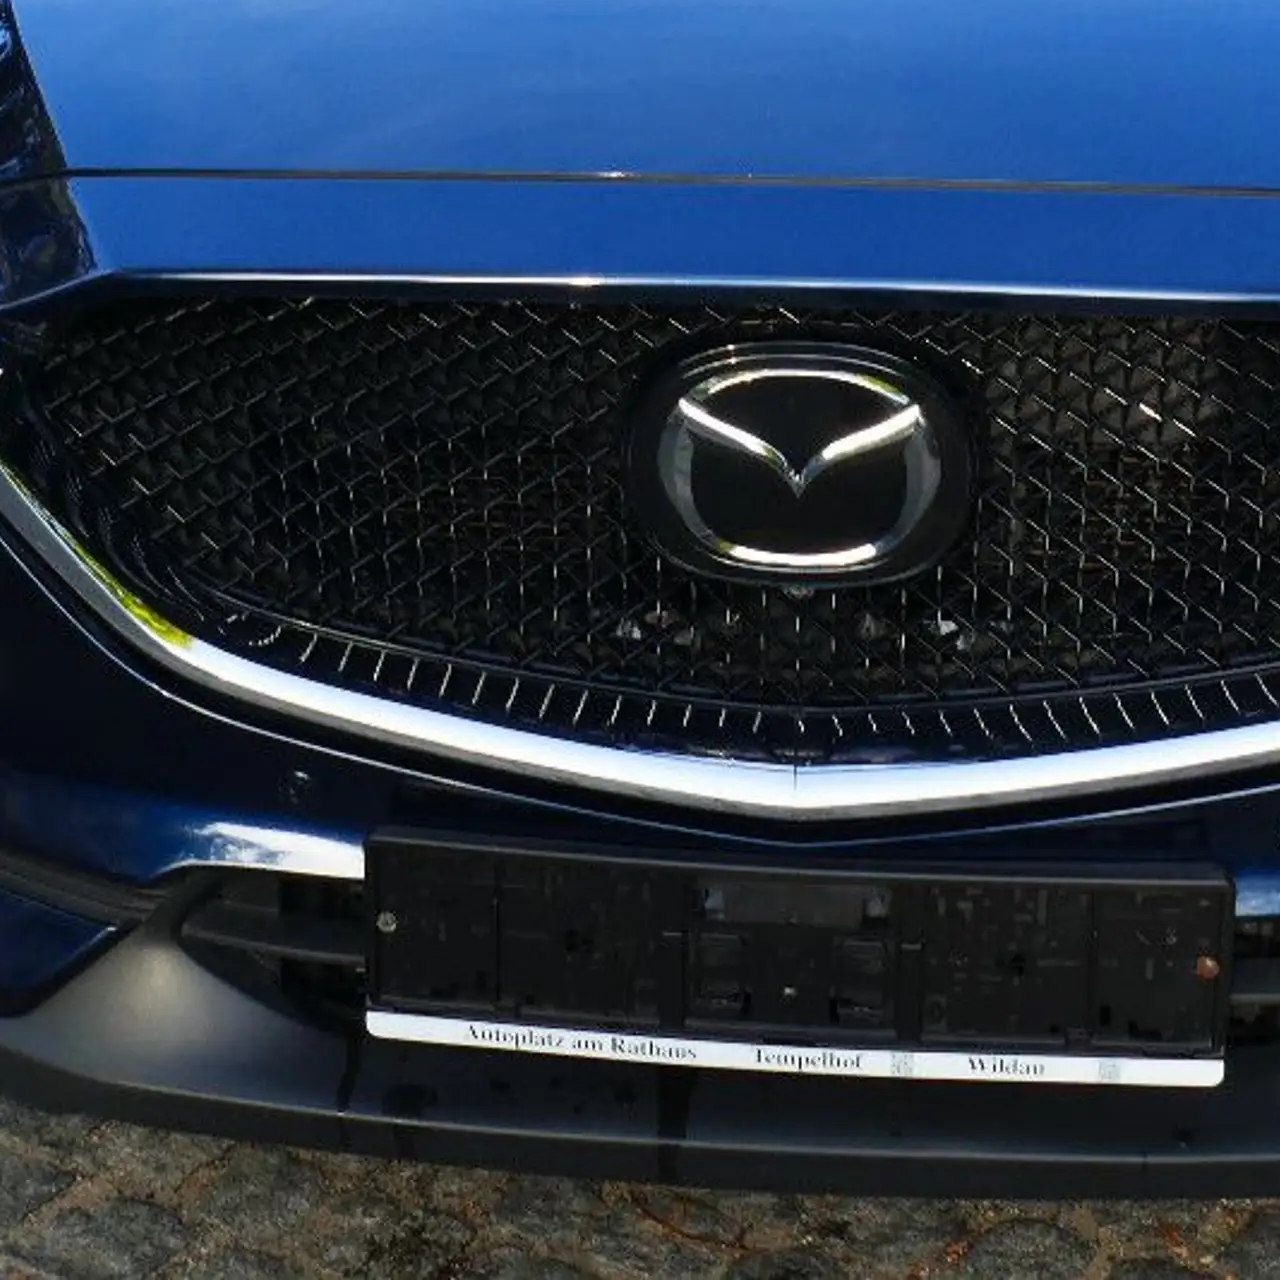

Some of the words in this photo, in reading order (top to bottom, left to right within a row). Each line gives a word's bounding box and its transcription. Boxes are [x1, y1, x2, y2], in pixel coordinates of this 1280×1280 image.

[467, 1024, 564, 1049] Autoplatz
[572, 1037, 604, 1052] am
[610, 1035, 697, 1060] Rathaus
[754, 1047, 862, 1072] Tempelhof
[968, 1055, 1045, 1077] Wildau
